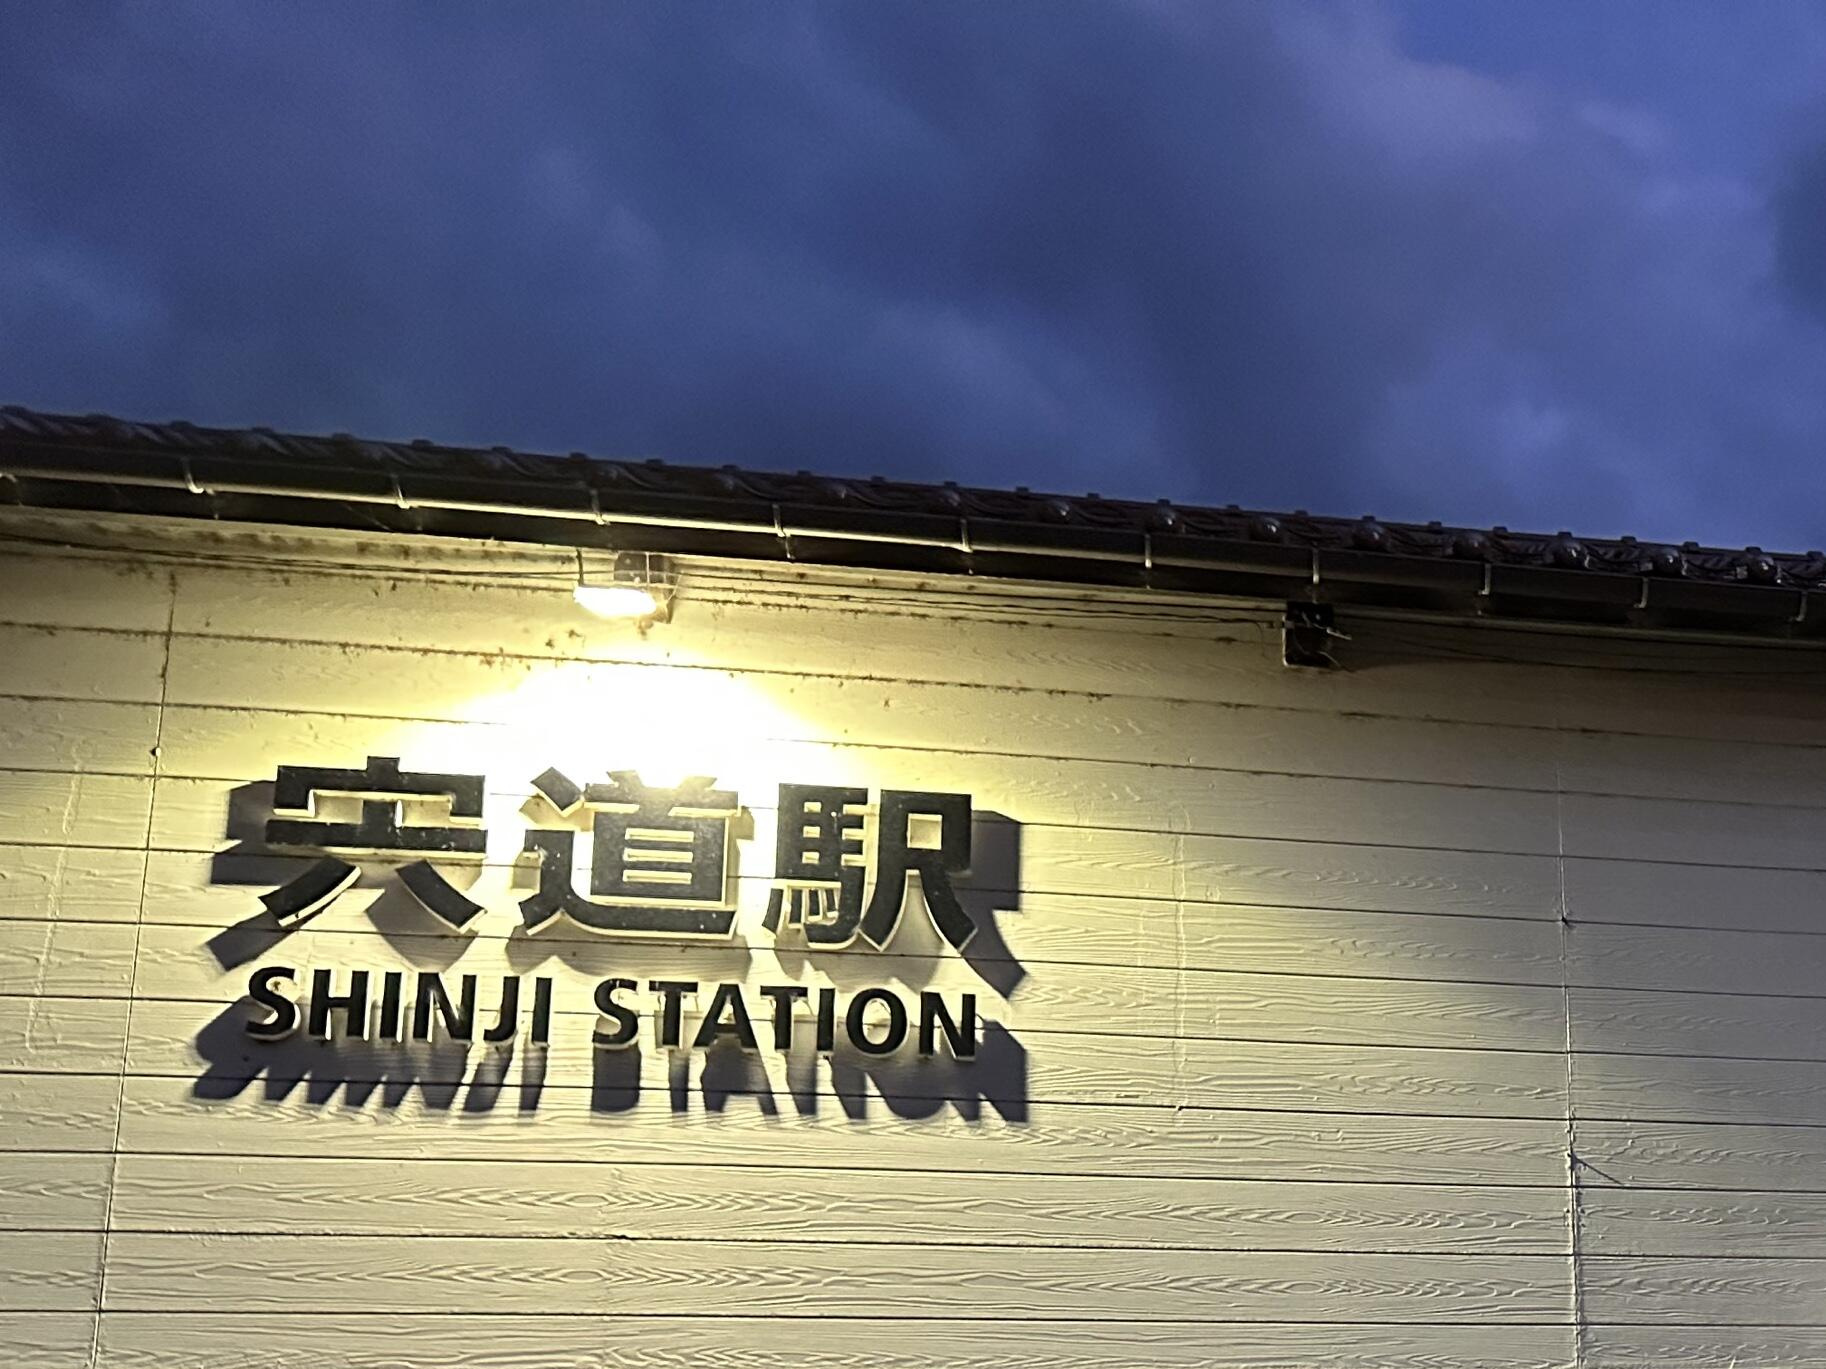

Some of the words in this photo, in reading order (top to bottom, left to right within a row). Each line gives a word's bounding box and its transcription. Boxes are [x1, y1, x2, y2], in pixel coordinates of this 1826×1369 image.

[258, 756, 978, 951] 宍道駅
[246, 966, 553, 1046] SHINJI
[593, 977, 977, 1062] STATION
